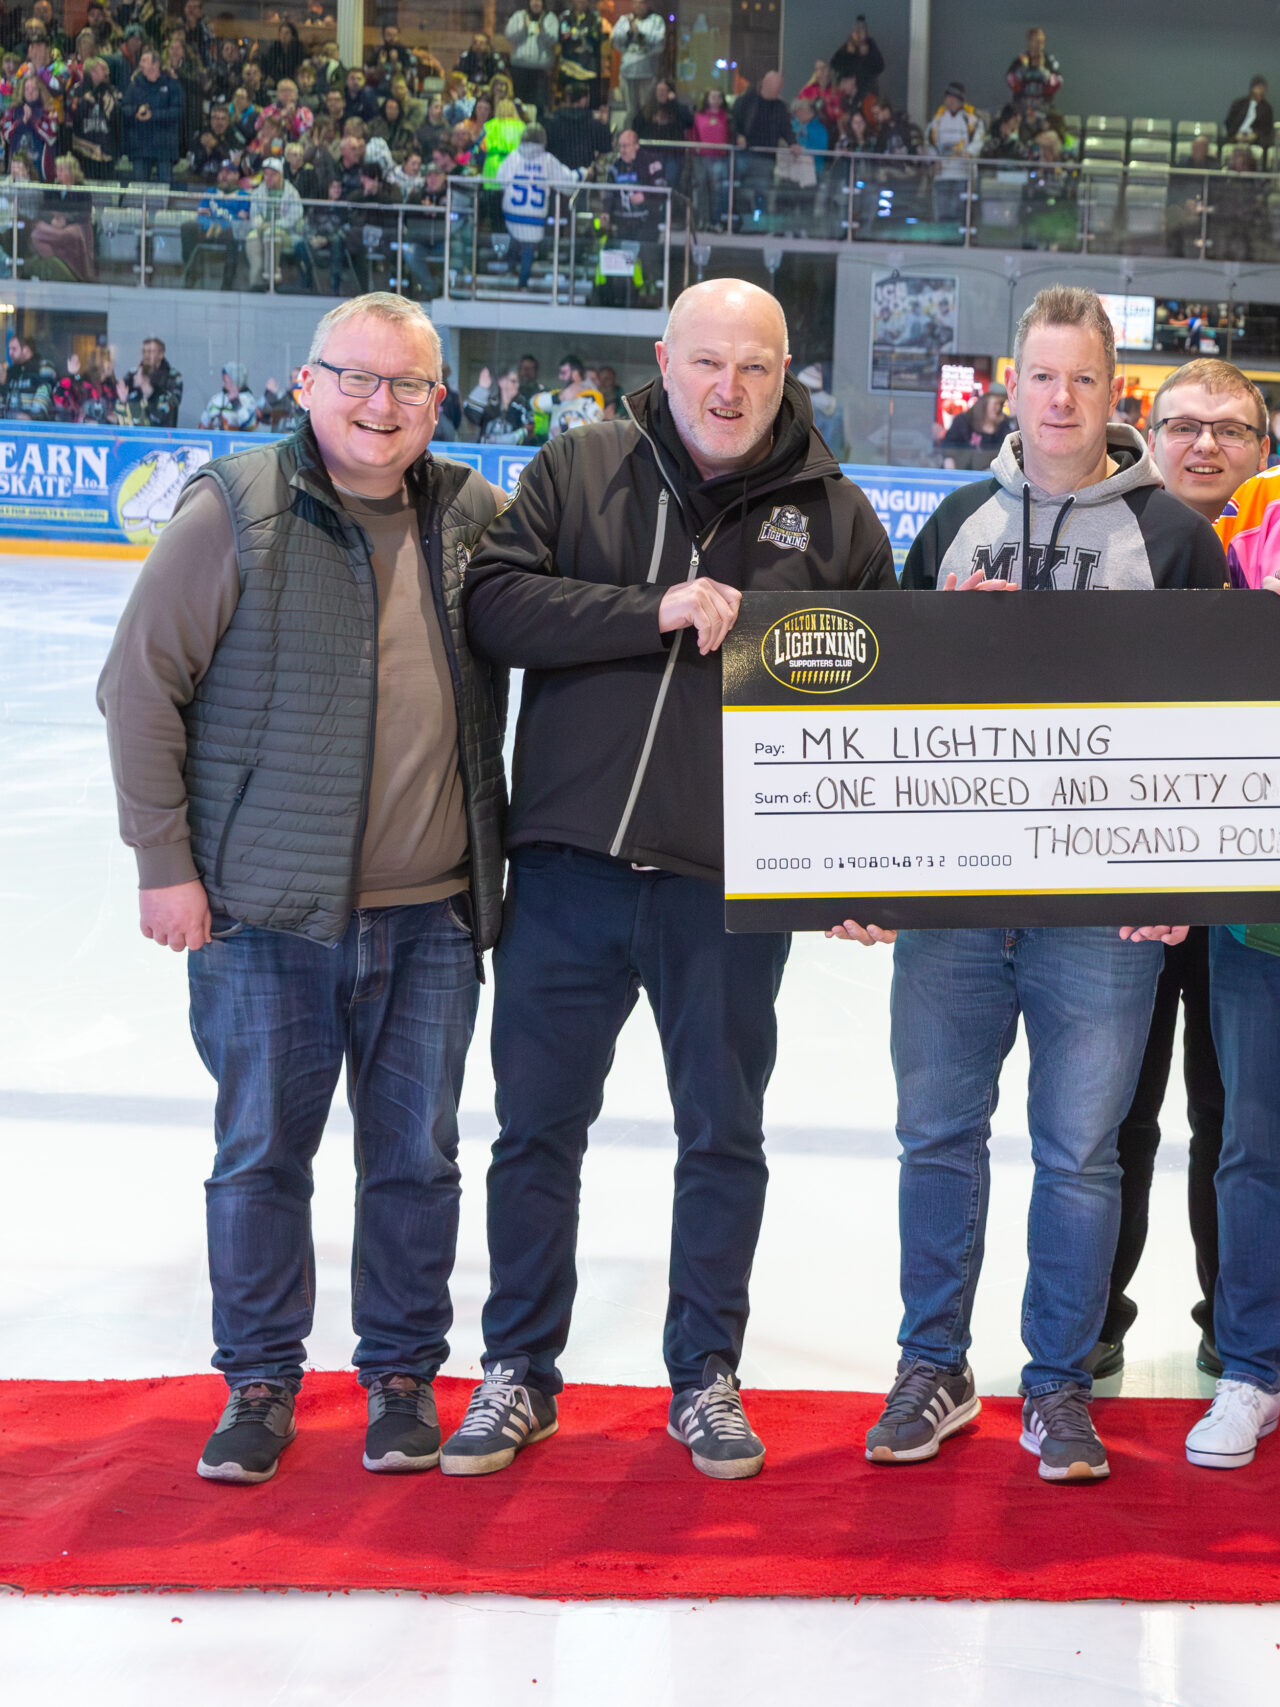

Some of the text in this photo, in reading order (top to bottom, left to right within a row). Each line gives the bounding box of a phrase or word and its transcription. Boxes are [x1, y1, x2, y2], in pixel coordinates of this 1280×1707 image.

[760, 526, 807, 549] LIGHTNING
[784, 613, 854, 631] MILTON KEYNES
[774, 628, 866, 666] LIGHTNING
[788, 659, 853, 667] SUPPORTERS CLUB
[754, 724, 1112, 760] Pay: MK LIGHTNING
[754, 792, 789, 804] Sum
[793, 791, 811, 804] of:
[815, 776, 876, 809] ONE
[895, 775, 1030, 807] HUNDRED
[1051, 775, 1108, 806] AND
[1129, 773, 1228, 803] SIXTY
[1024, 824, 1200, 859] THOUSAND
[756, 858, 811, 869] 00000
[958, 854, 1012, 867] 00000
